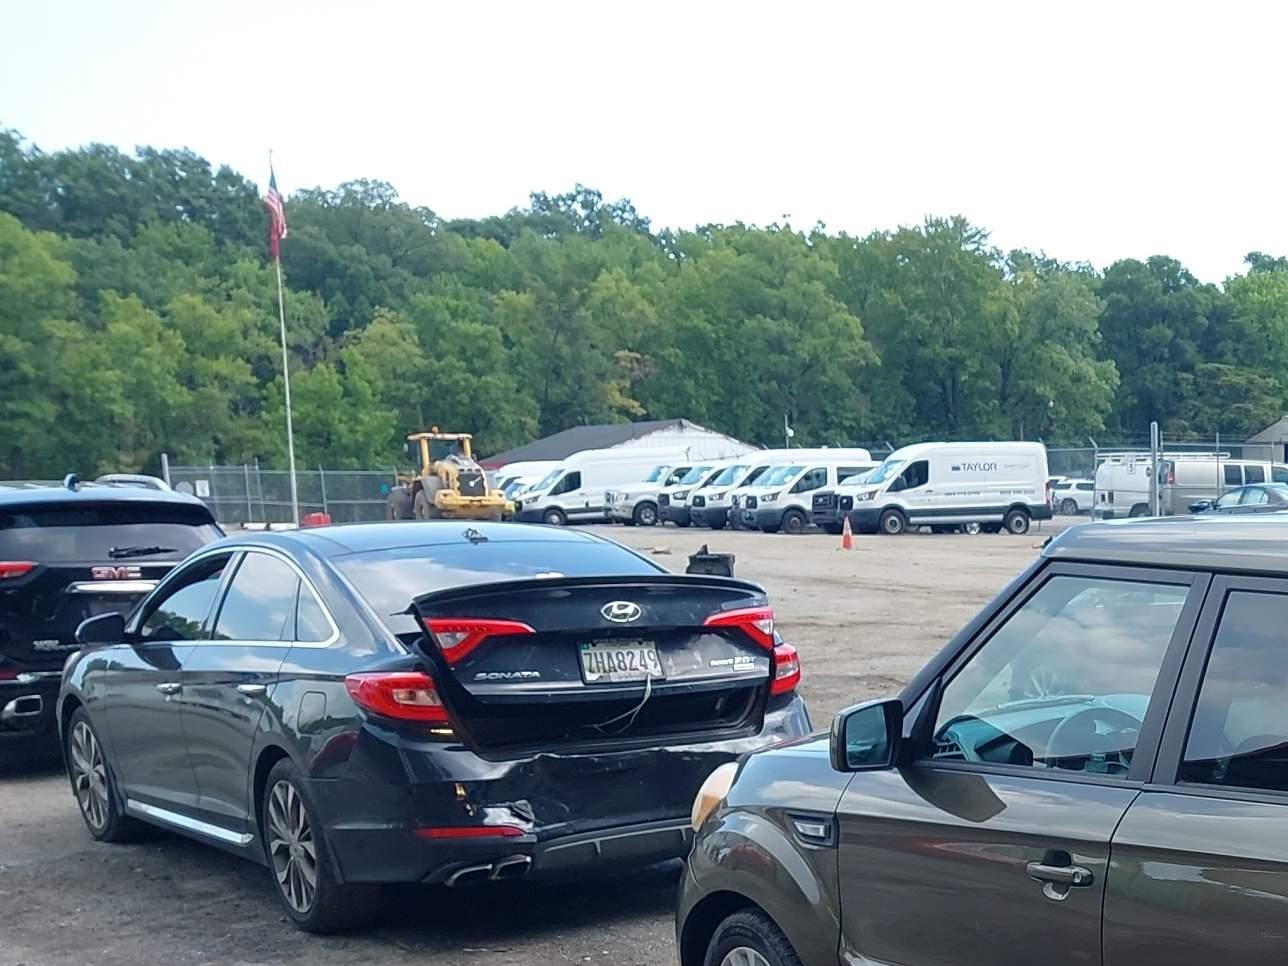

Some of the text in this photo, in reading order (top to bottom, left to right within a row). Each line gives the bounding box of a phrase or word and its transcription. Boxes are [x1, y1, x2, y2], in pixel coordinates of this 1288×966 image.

[961, 463, 997, 471] TAYLOR
[91, 567, 142, 578] GMC
[474, 671, 541, 680] SONATA
